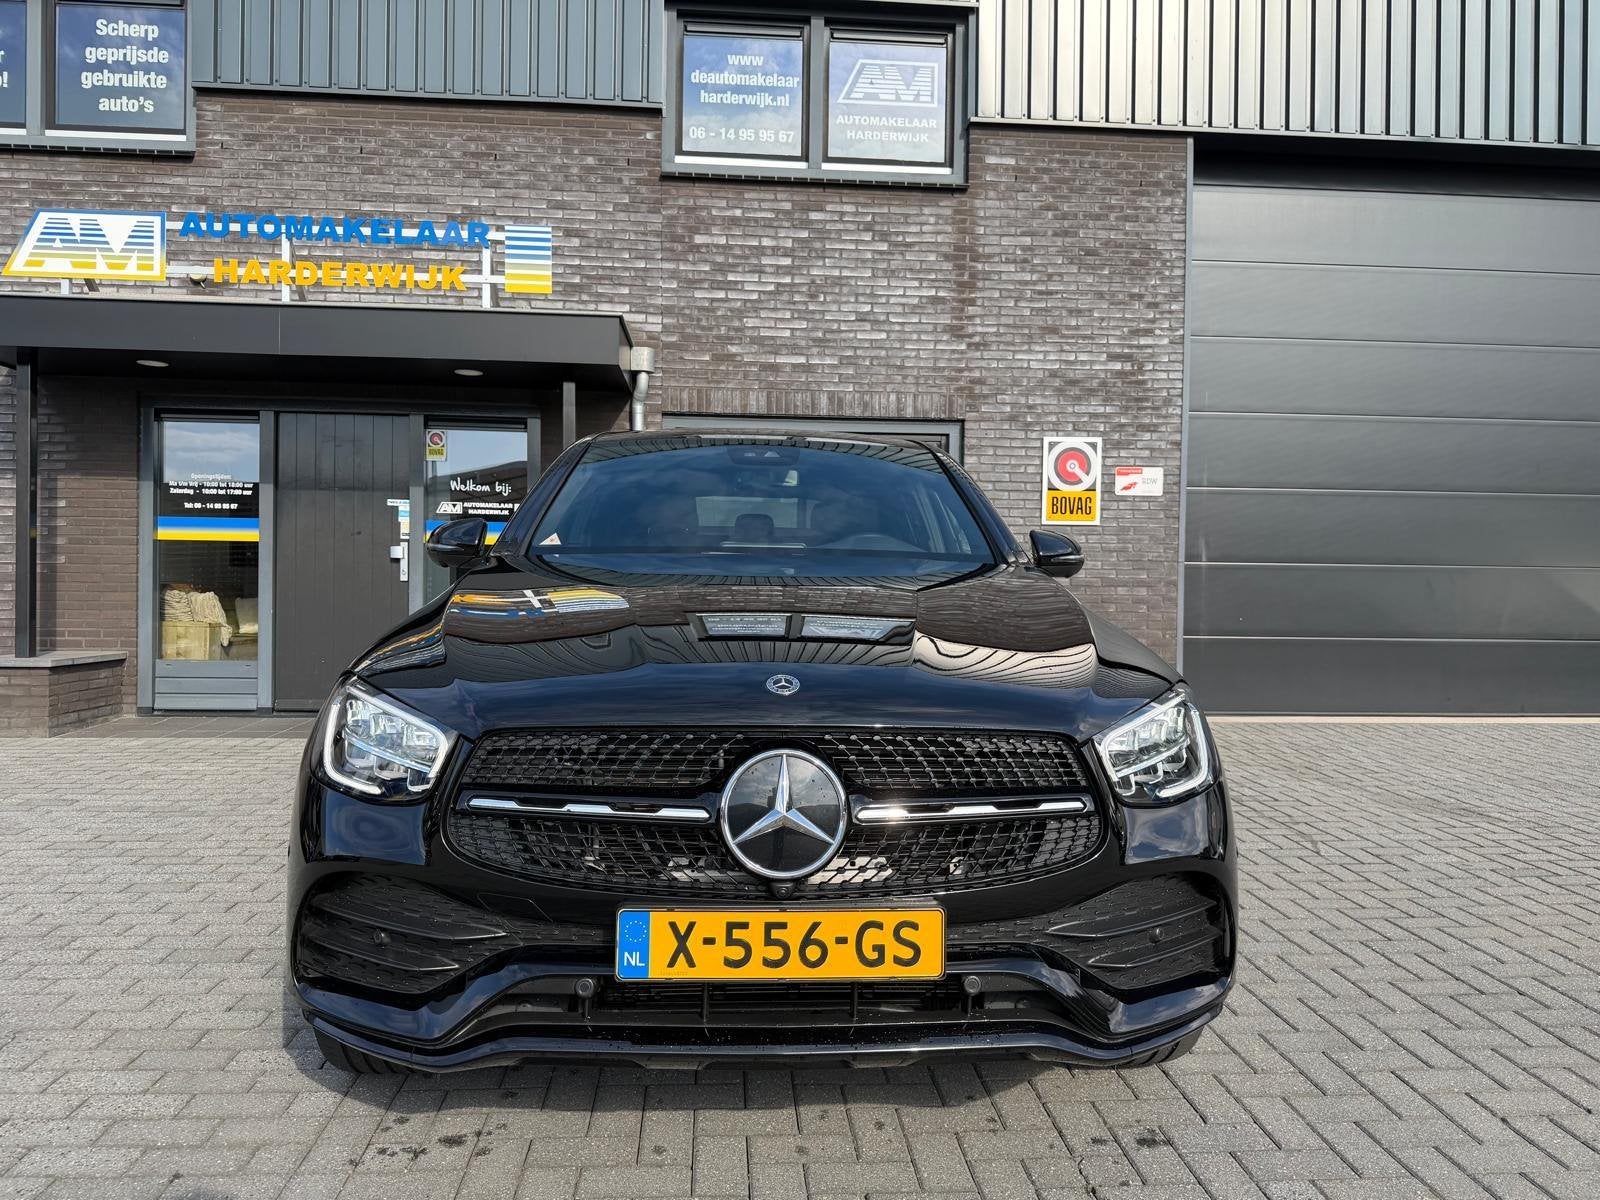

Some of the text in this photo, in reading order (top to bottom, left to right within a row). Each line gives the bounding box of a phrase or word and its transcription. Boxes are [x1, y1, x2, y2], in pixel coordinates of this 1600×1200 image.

[95, 18, 159, 41] Scherp
[85, 46, 169, 65] geprijsde
[727, 54, 764, 66] www
[81, 69, 167, 89] gebruikte
[691, 69, 800, 89] deautomakelaar
[700, 89, 790, 108] harderwijk.nl
[836, 115, 937, 129] AUTOMAKELAAR
[689, 126, 706, 140] 06
[719, 127, 735, 141] 14
[739, 128, 755, 142] 95
[759, 128, 775, 142] 95
[778, 129, 795, 143] 67
[846, 130, 929, 142] HARDERWIJK
[179, 212, 491, 248] AUTOMAKELAAR
[213, 257, 467, 291] HARDERWIJK
[450, 477, 512, 496] Welkom bij:
[1051, 496, 1092, 515] BOVAG
[666, 919, 922, 969] X-556-GS
[623, 951, 646, 967] NL
